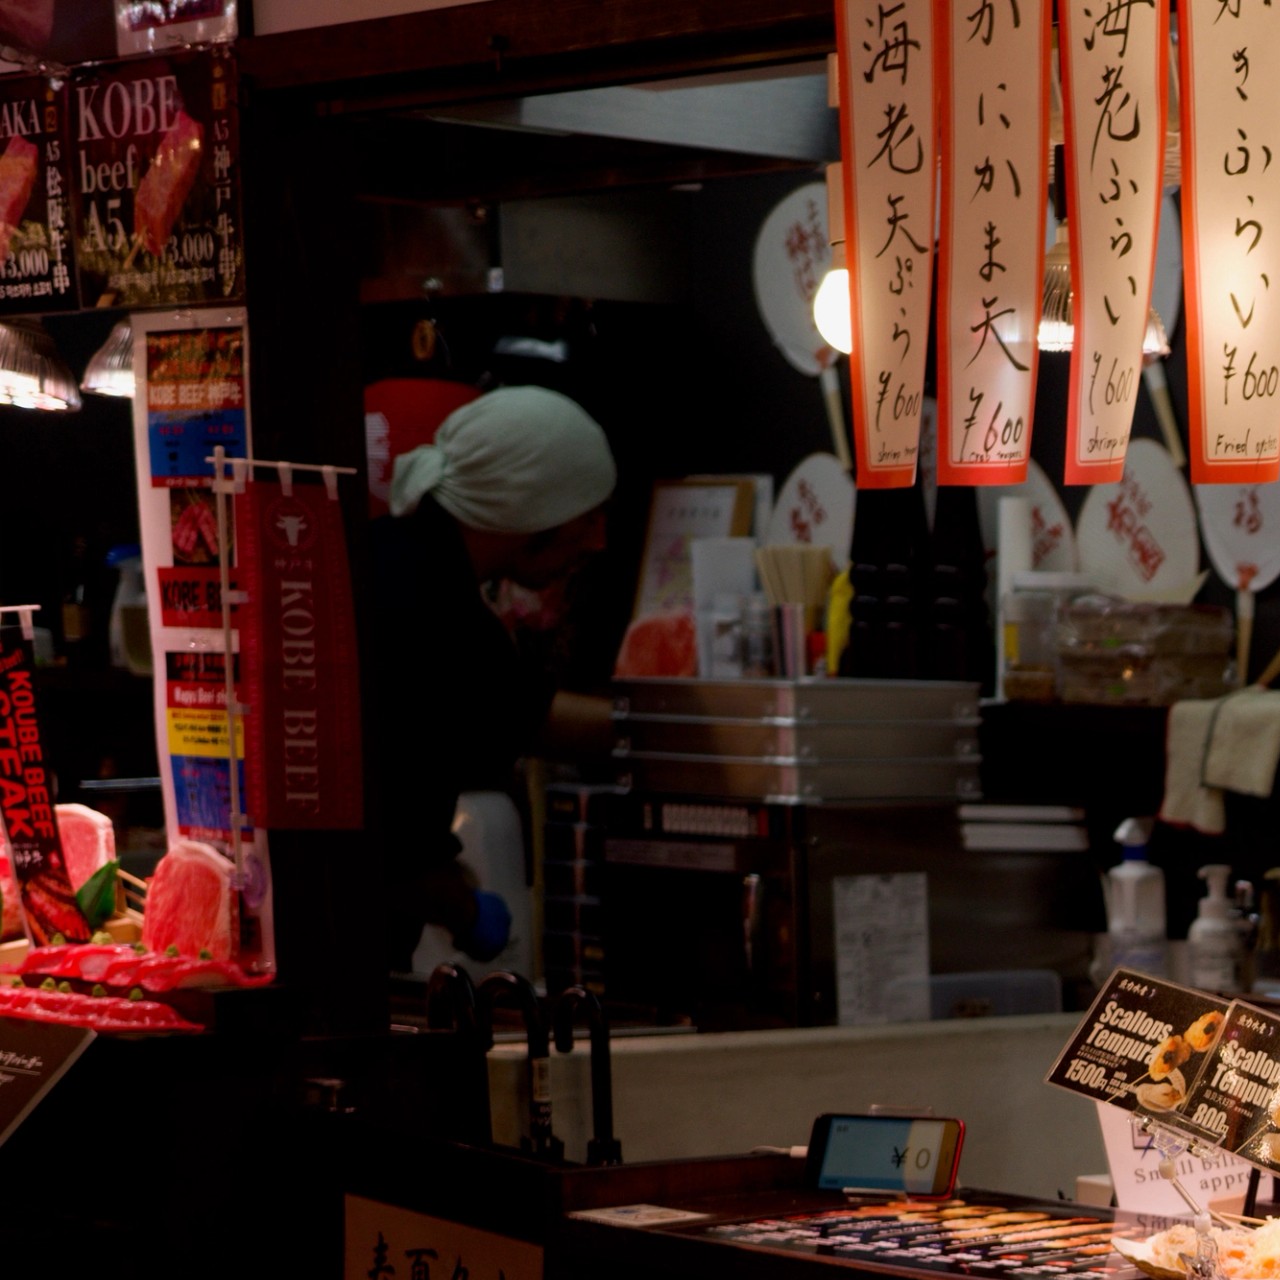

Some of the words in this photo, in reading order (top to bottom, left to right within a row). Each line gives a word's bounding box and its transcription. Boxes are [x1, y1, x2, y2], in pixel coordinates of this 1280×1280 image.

[76, 75, 179, 142] KOBE
[81, 143, 136, 194] beef
[863, 3, 929, 362] 海老天ぷら
[960, 0, 1030, 374] かにかま天
[1083, 0, 1154, 326] 海老ふらい
[875, 370, 921, 432] ¥600
[1088, 351, 1134, 415] ¥600
[1222, 342, 1279, 405] ¥600
[960, 386, 1024, 464] ¥600
[1215, 428, 1250, 455] Fried
[280, 580, 317, 691] KOBE
[6, 670, 43, 764] KOUBE
[24, 767, 55, 839] BEEF
[1086, 1022, 1158, 1066] Tempura
[1099, 1000, 1174, 1043] Scallops
[1064, 1057, 1109, 1092] 1500円
[1191, 1102, 1230, 1135] 800円
[1133, 1158, 1194, 1184] Smll
